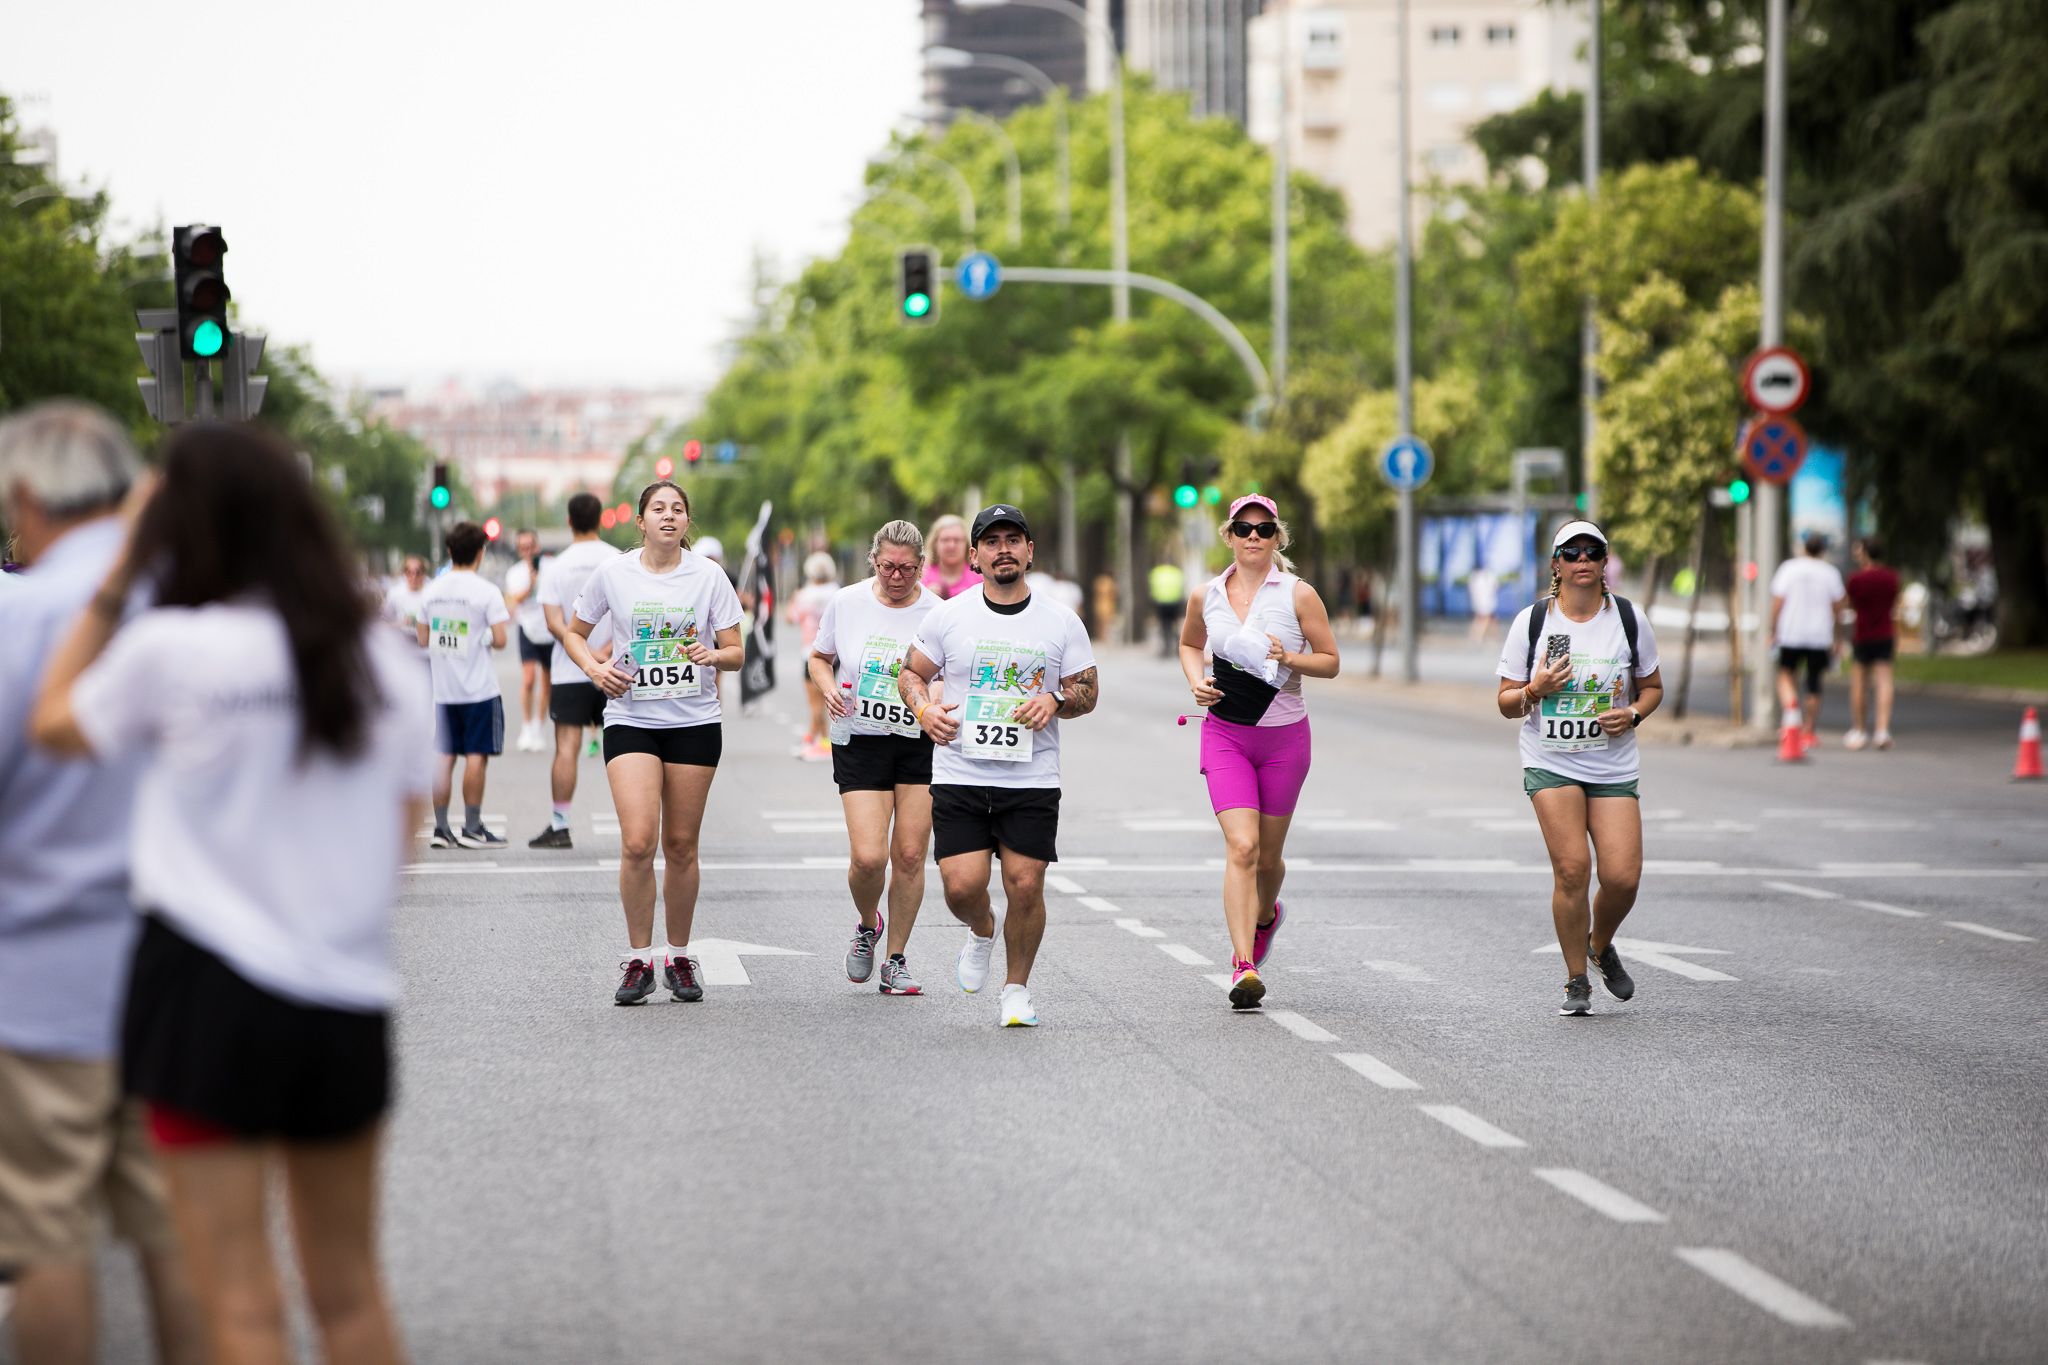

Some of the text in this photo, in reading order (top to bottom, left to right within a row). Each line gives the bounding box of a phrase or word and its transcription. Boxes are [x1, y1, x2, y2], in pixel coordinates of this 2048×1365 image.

[864, 640, 898, 649] MADRID
[637, 664, 695, 687] 1054
[860, 699, 915, 727] 1055
[1556, 694, 1597, 715] ELA
[975, 724, 1019, 747] 325
[1546, 719, 1602, 740] 1010
